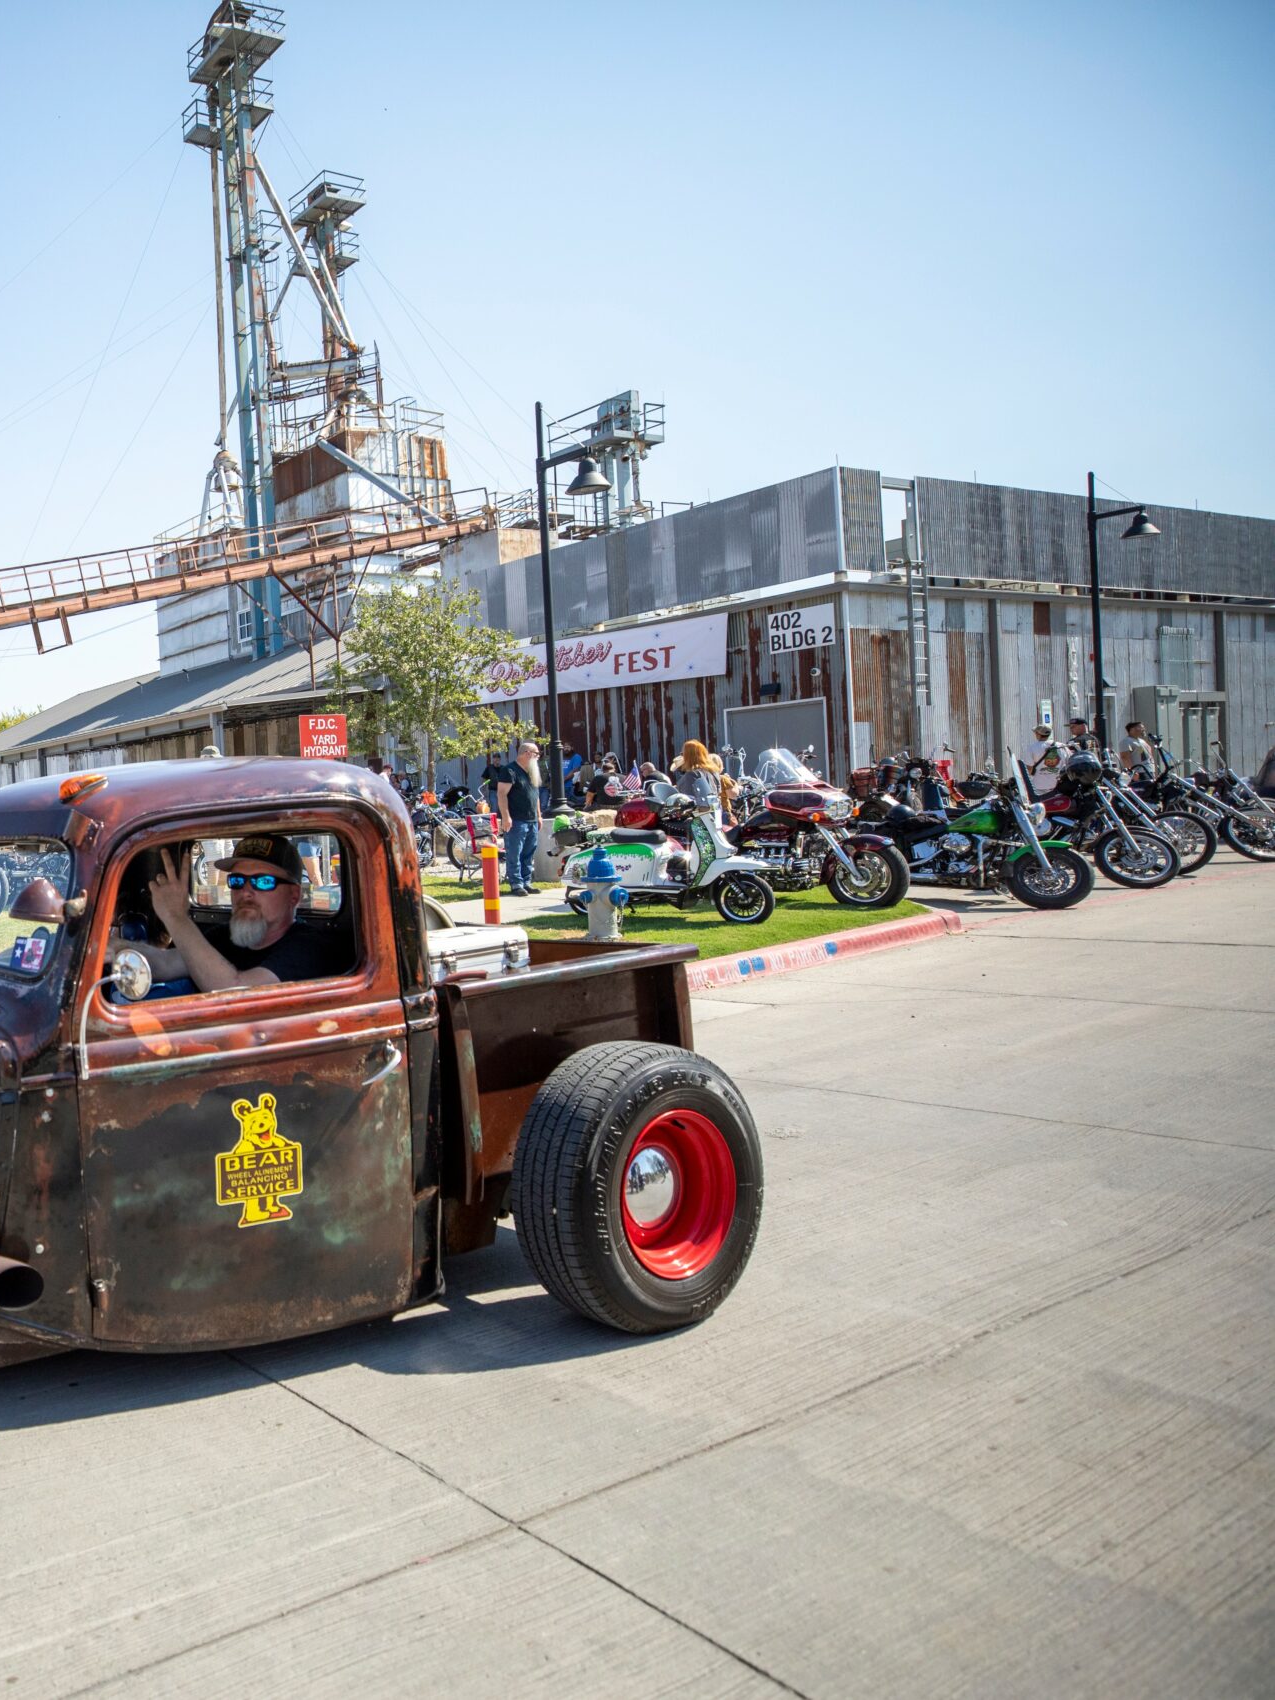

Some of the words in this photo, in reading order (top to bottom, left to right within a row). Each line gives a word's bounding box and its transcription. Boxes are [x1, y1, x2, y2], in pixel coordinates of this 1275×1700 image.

[770, 611, 802, 631] 402
[771, 628, 816, 652] BLDG
[821, 626, 833, 643] 2
[614, 645, 676, 675] FEST
[308, 718, 338, 730] F.D.C.
[311, 734, 338, 745] YARD
[303, 744, 347, 757] HYDRANT
[225, 1149, 294, 1172] BEAR
[227, 1171, 252, 1180] WHEEL
[254, 1164, 293, 1177] ALINEMENT
[230, 1172, 289, 1188] BALANCING
[225, 1178, 295, 1199] SERVICE
